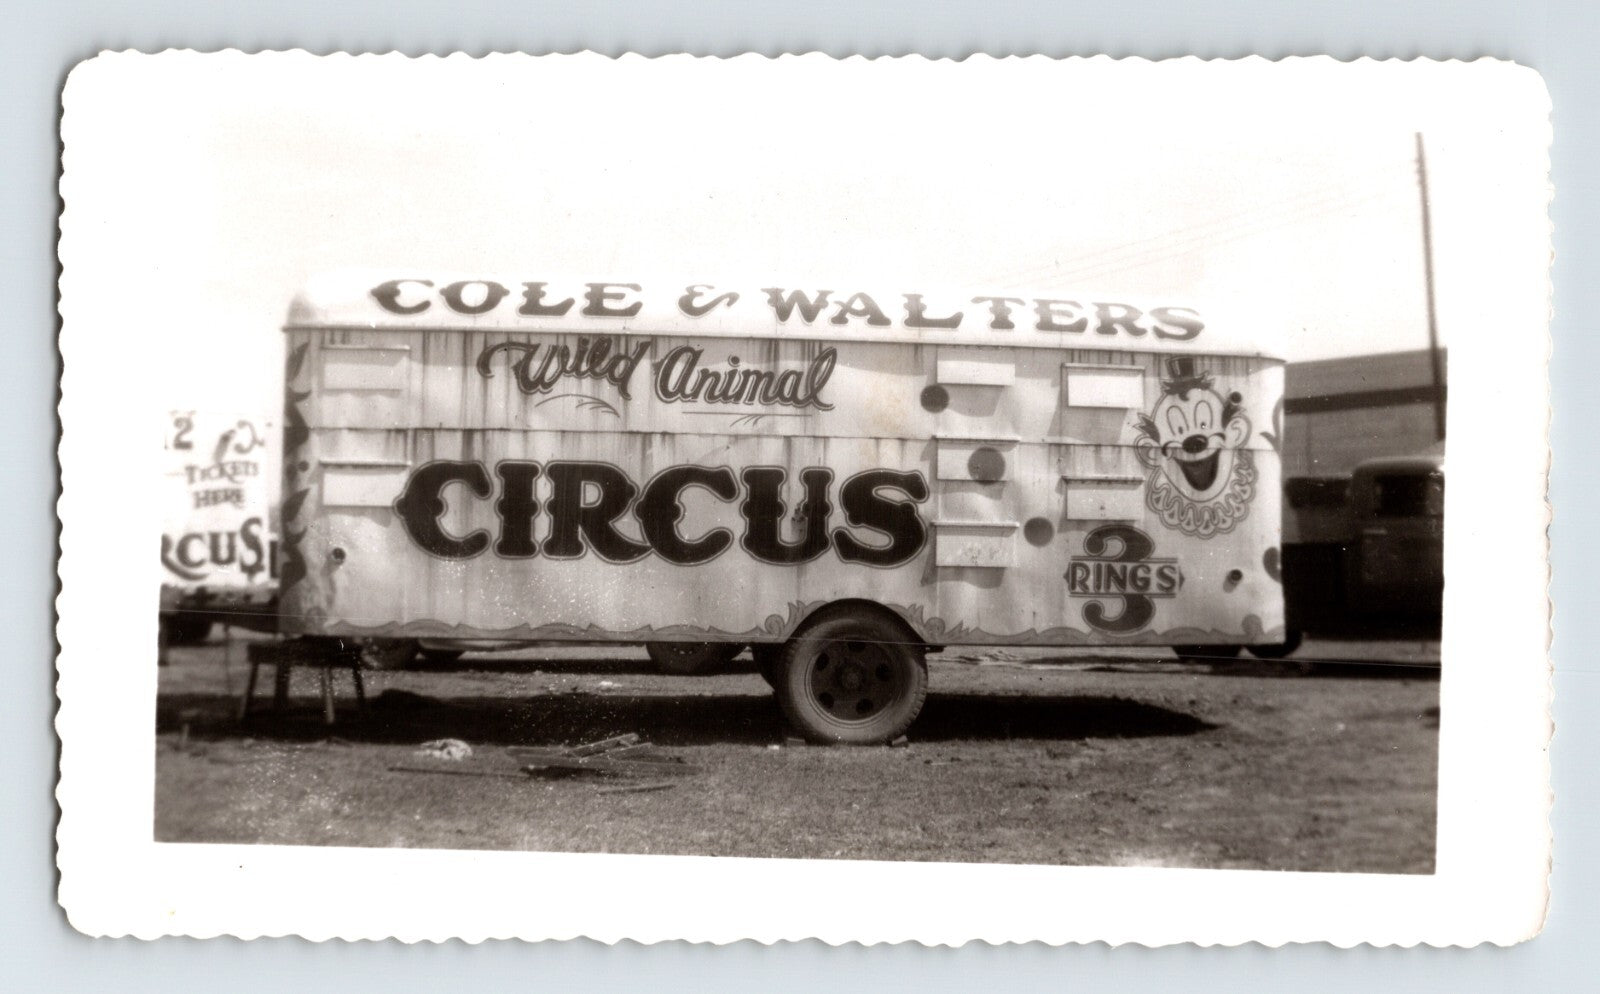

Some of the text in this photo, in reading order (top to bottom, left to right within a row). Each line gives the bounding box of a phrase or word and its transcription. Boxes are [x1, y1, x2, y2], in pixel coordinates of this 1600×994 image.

[370, 278, 1206, 341] COLE & WALTERS
[476, 336, 838, 411] Wild Animal
[192, 487, 246, 511] HERE
[394, 459, 929, 568] CIRCUS
[1069, 562, 1178, 594] RINGS
[1081, 524, 1157, 634] 3
